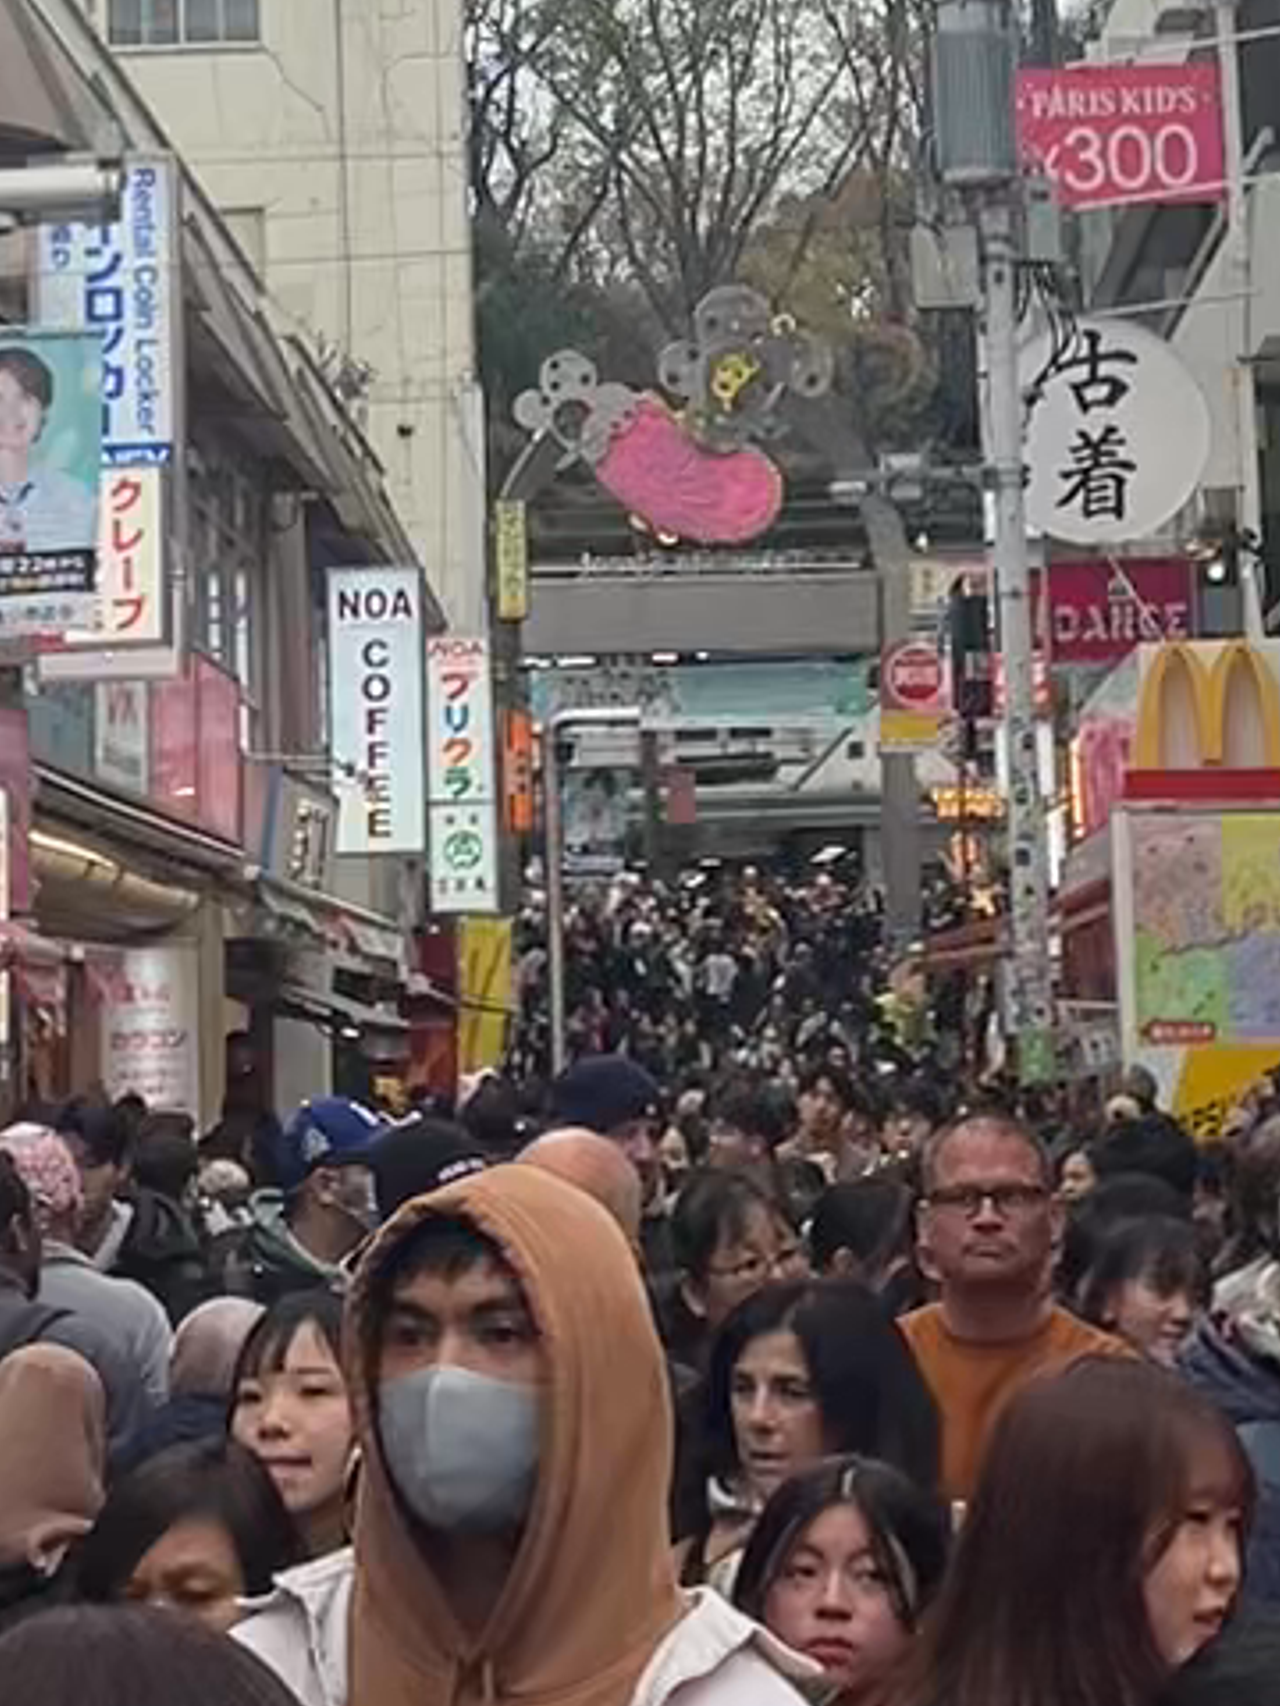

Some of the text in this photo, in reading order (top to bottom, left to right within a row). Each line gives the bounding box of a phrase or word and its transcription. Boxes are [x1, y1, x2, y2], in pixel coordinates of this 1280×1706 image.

[1032, 86, 1116, 117] PARIS
[1064, 124, 1199, 191] 300
[131, 167, 159, 436] Rental Coin Locker
[1056, 329, 1138, 520] 古着
[338, 589, 412, 620] NOA
[362, 639, 392, 839] COFFEE
